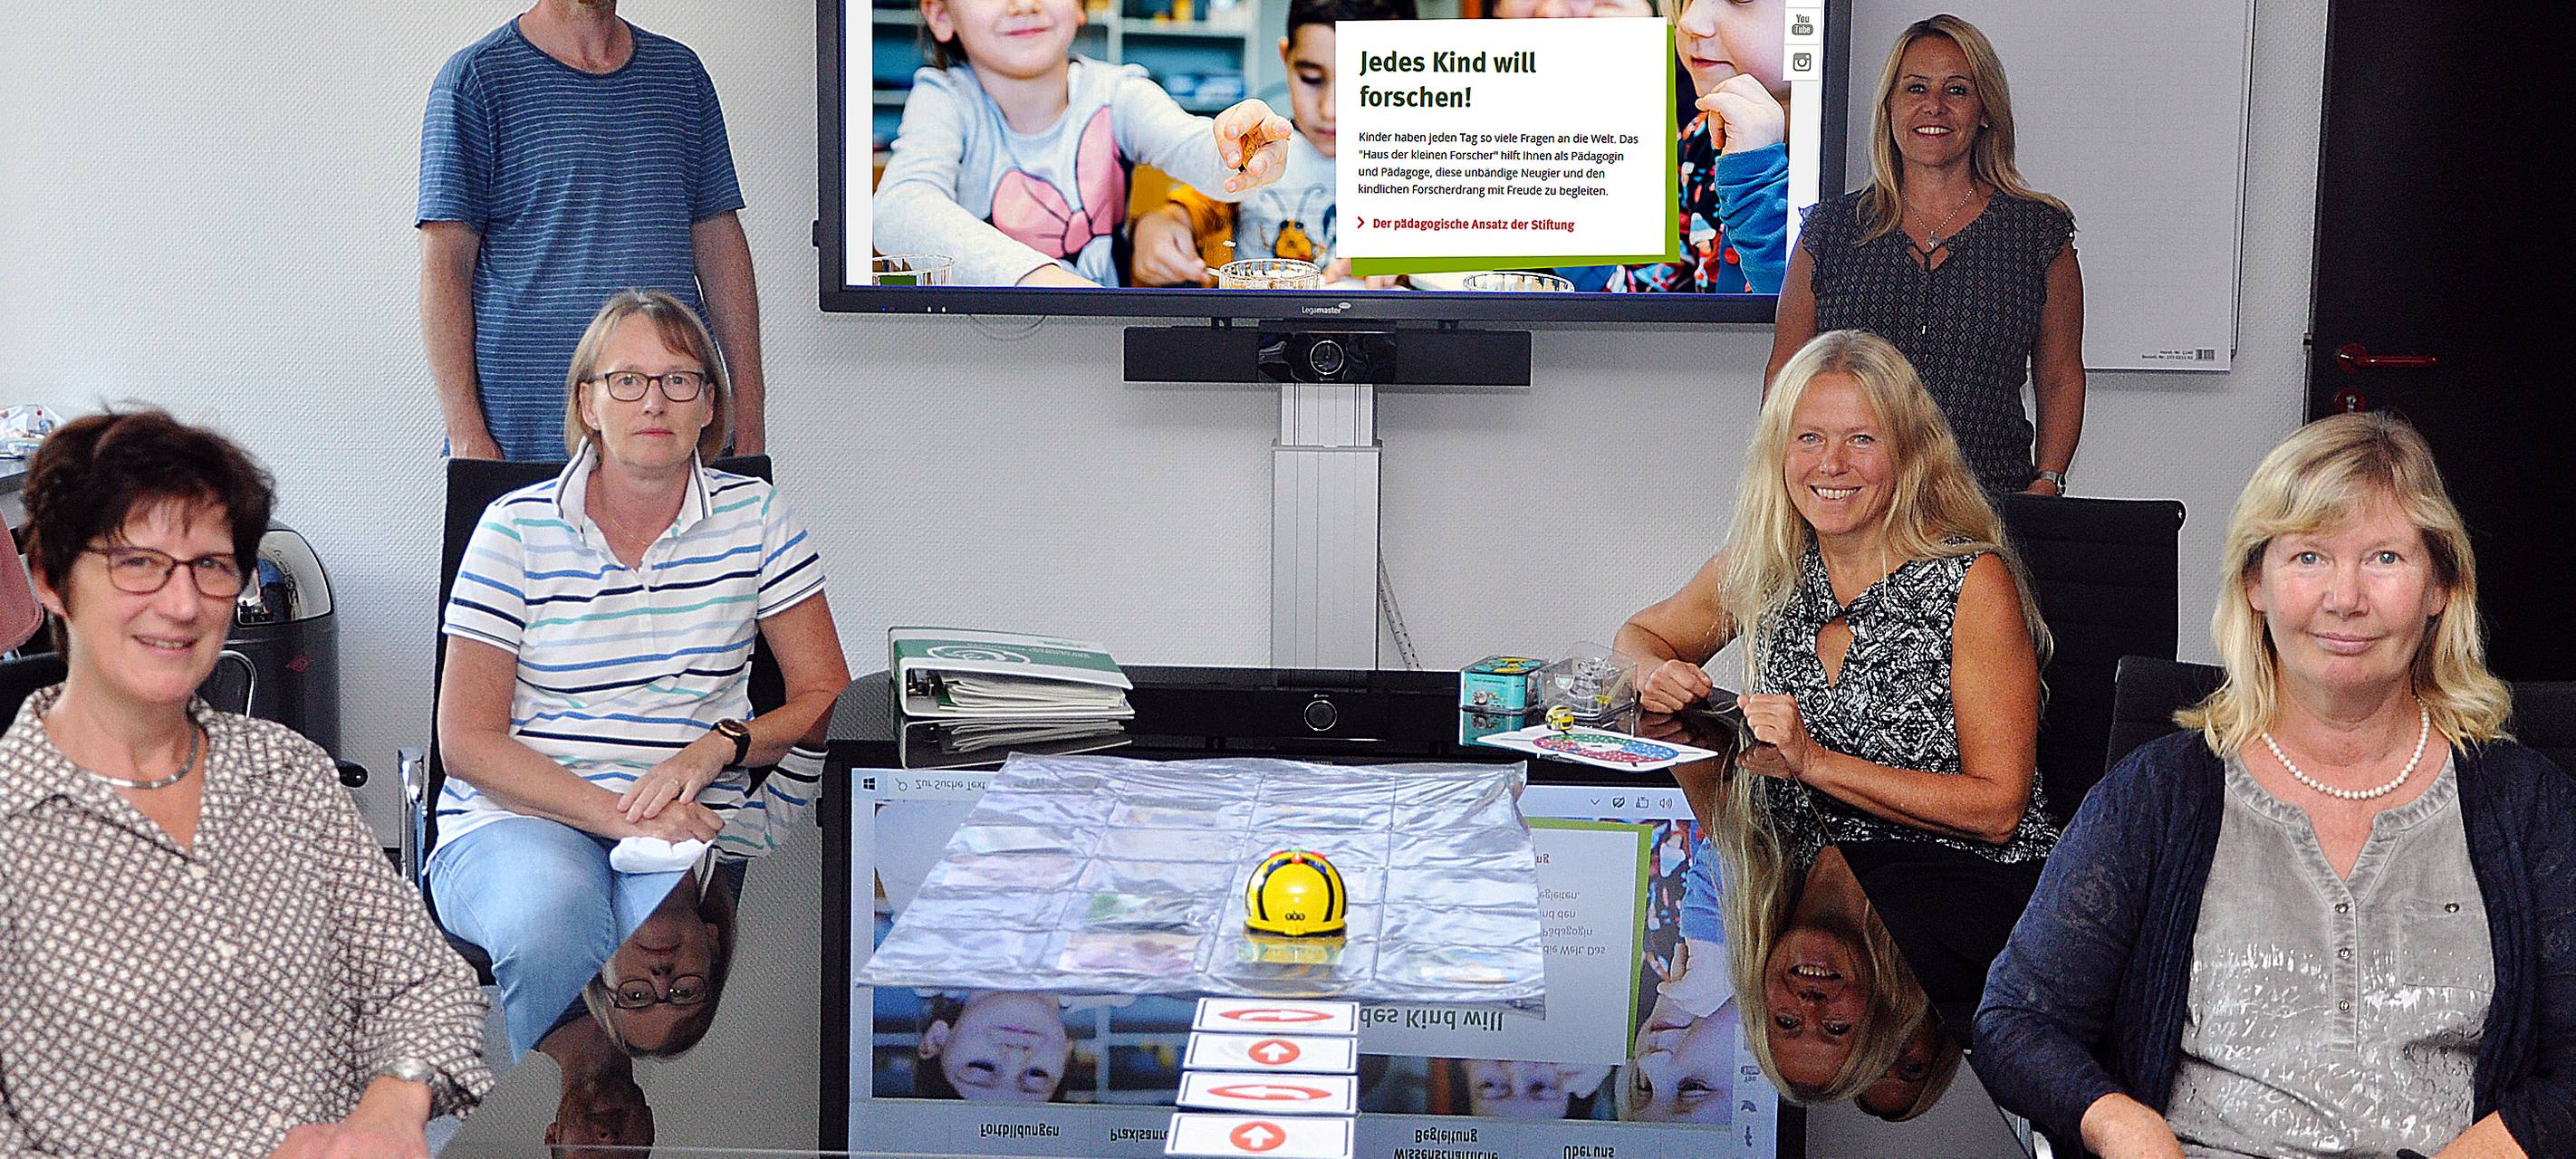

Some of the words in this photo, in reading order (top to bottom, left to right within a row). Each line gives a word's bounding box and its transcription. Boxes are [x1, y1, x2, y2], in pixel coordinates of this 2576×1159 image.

[1796, 14, 1810, 23] You
[1795, 25, 1811, 34] Tube
[1360, 51, 1425, 76] Jedes
[1433, 51, 1485, 72] Kind
[1494, 51, 1536, 73] will
[1360, 85, 1472, 108] forschen!
[1359, 132, 1391, 142] Kinder
[1395, 132, 1427, 142] haben
[1428, 133, 1456, 145] jeden
[1460, 133, 1478, 145] Tag
[1495, 133, 1518, 143] viele
[1520, 134, 1554, 146] Fragen
[1572, 134, 1589, 143] die
[1591, 134, 1616, 144] Welt.
[1620, 134, 1638, 144] Das
[1359, 149, 1389, 159] "Haus
[1391, 149, 1408, 159] der
[1411, 149, 1447, 159] kleinen
[1450, 150, 1498, 159] Forscher"
[1500, 150, 1520, 160] hilft
[1523, 150, 1552, 160] Ihnen
[1554, 151, 1569, 161] als
[1571, 151, 1624, 164] Pädagogin
[1359, 167, 1379, 177] und
[1381, 167, 1433, 179] Pädagoge,
[1435, 168, 1462, 177] diese
[1465, 168, 1518, 181] unbändige
[1521, 168, 1562, 181] Neugier
[1563, 168, 1583, 178] und
[1586, 168, 1605, 178] den
[1359, 184, 1409, 194] kindlichen
[1412, 185, 1485, 197] Forscherdrang
[1487, 185, 1504, 195] mit
[1507, 185, 1542, 196] Freude
[1545, 187, 1556, 196] zu
[1559, 187, 1609, 199] begleiten.
[1373, 219, 1391, 228] Der
[1394, 218, 1469, 231] pädagogische
[1471, 219, 1508, 229] Ansatz
[1511, 219, 1529, 230] der
[1531, 219, 1575, 233] Stiftung
[1302, 306, 1341, 315] Legamaster
